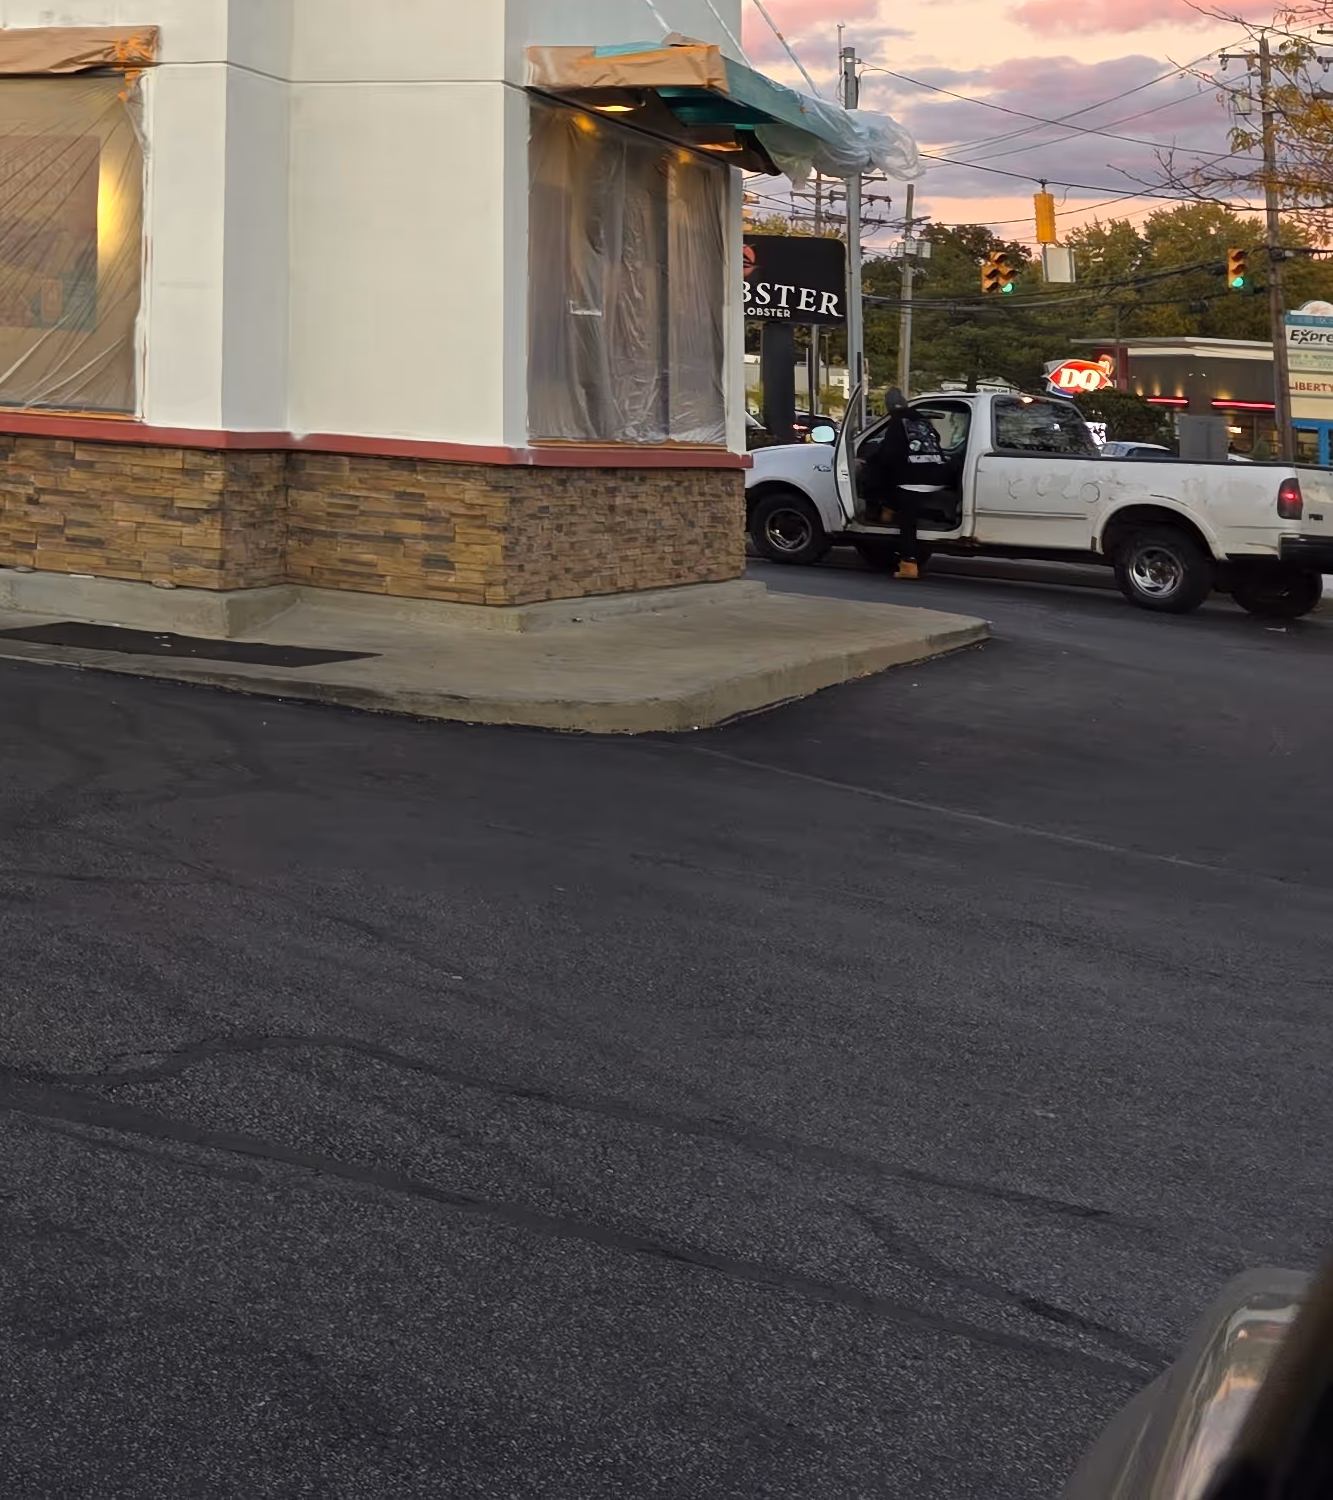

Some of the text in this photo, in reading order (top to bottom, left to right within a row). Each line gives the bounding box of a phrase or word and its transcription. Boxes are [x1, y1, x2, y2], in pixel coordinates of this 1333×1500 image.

[743, 307, 791, 318] OBSTER
[1059, 368, 1101, 392] DQ
[1289, 381, 1333, 393] IBERTY
